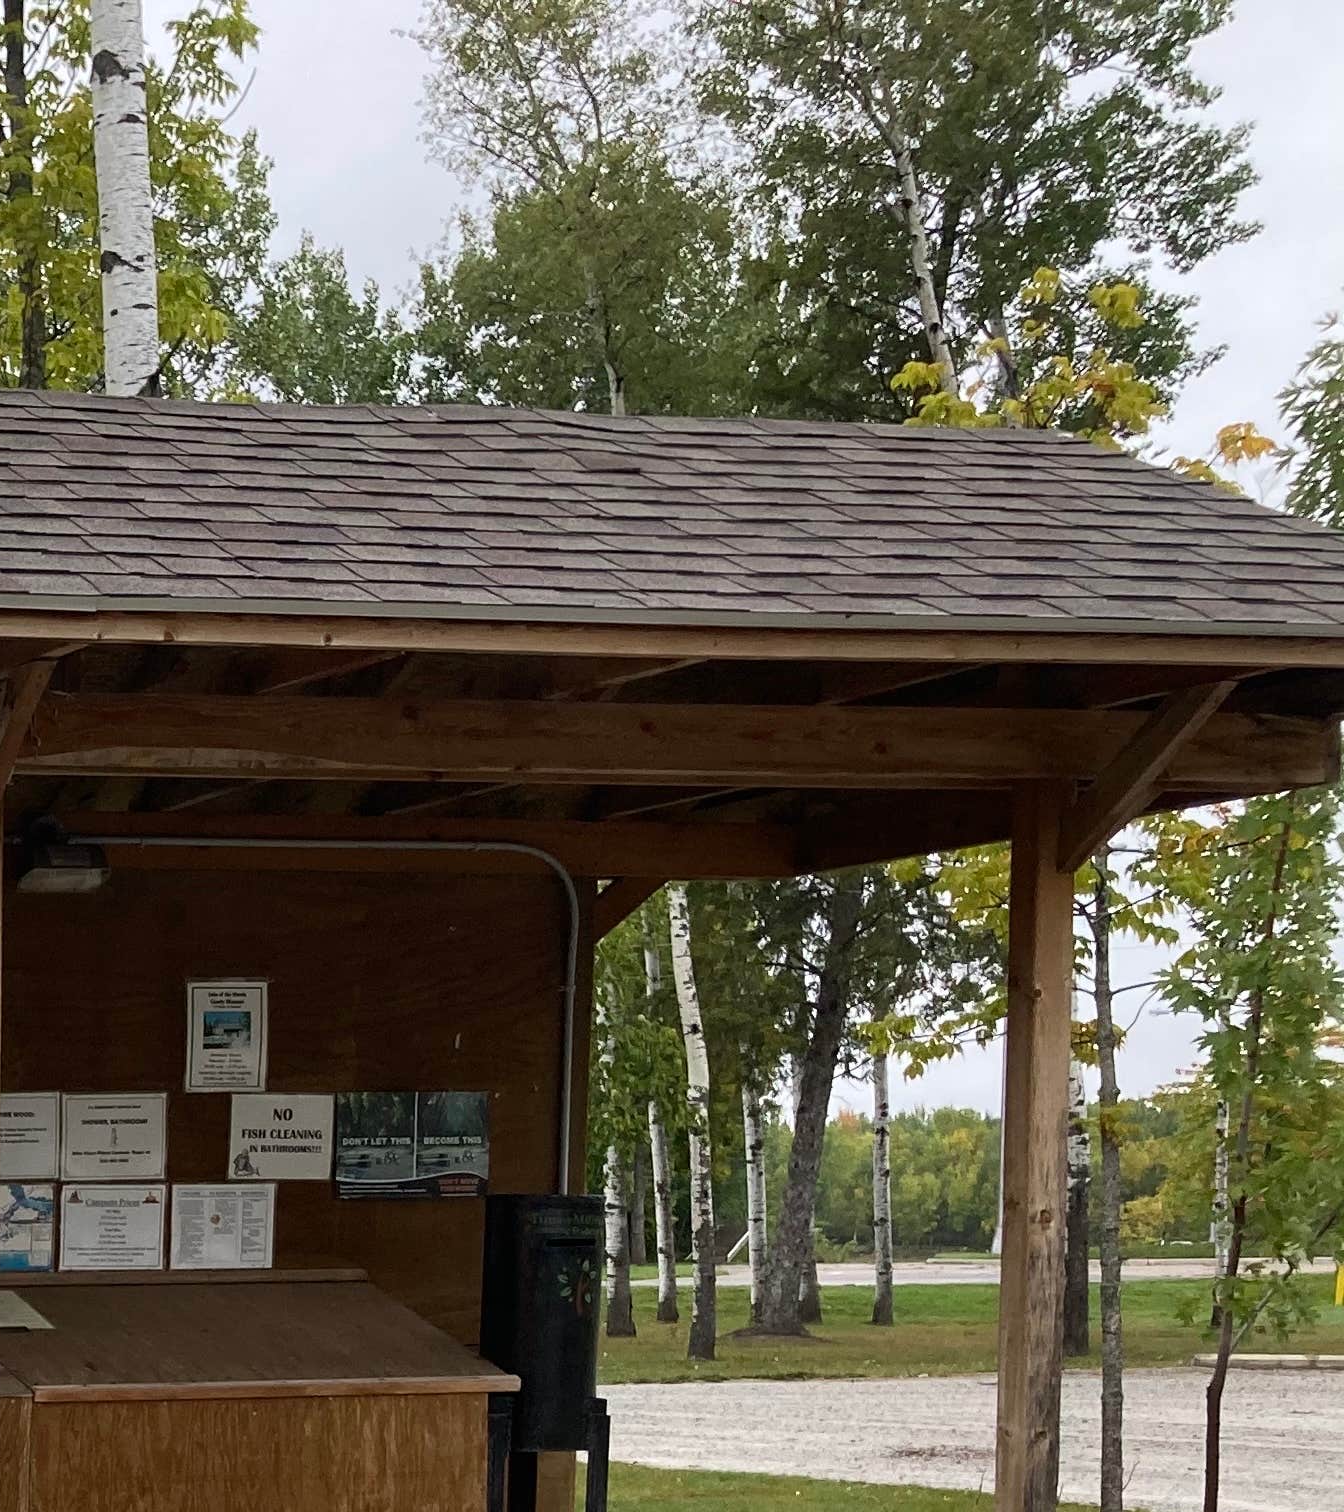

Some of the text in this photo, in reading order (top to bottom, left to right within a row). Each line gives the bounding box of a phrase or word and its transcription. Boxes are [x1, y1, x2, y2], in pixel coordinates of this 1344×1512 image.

[273, 1108, 293, 1121] NO
[241, 1128, 323, 1140] FISH CLEANING
[342, 1137, 411, 1146] DON'T LET THIS
[423, 1136, 482, 1145] BECOME THIS
[249, 1144, 258, 1153] IN
